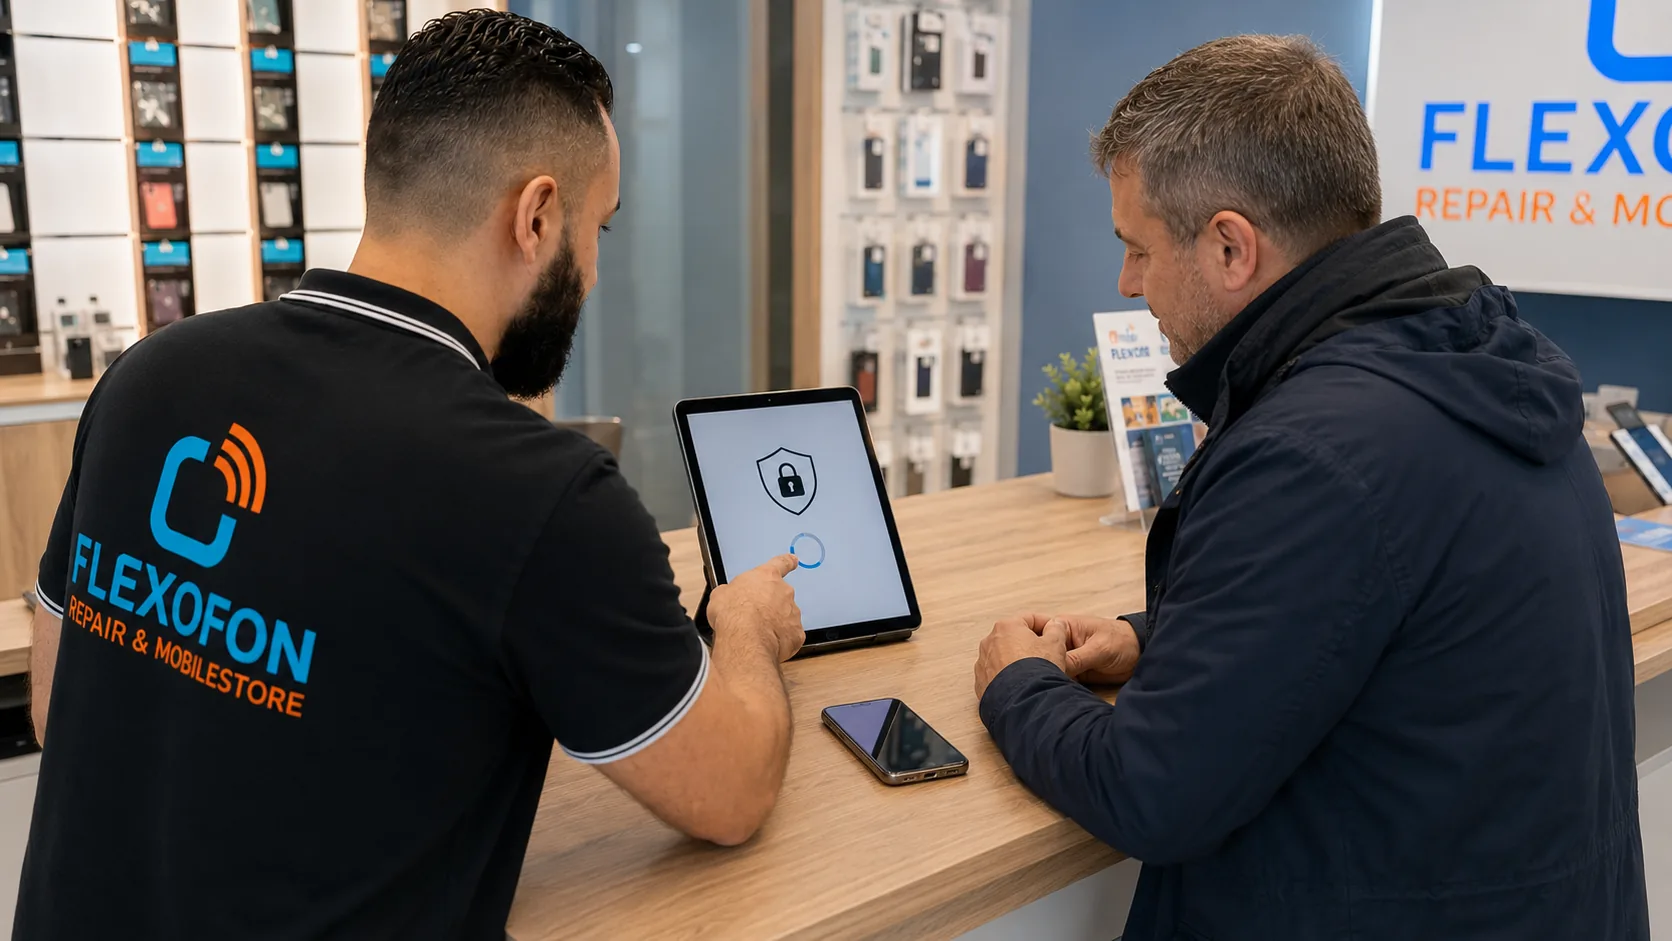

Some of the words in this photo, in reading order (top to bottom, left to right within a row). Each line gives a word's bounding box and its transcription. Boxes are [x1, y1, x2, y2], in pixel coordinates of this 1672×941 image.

[1419, 101, 1672, 175] FLEX
[1415, 187, 1555, 223] REPAIR
[1569, 190, 1595, 225] &
[68, 595, 127, 646] REPAIR
[132, 629, 148, 655] &
[154, 636, 305, 718] MOBILESTORE
[71, 532, 317, 684] FLEXOFON
